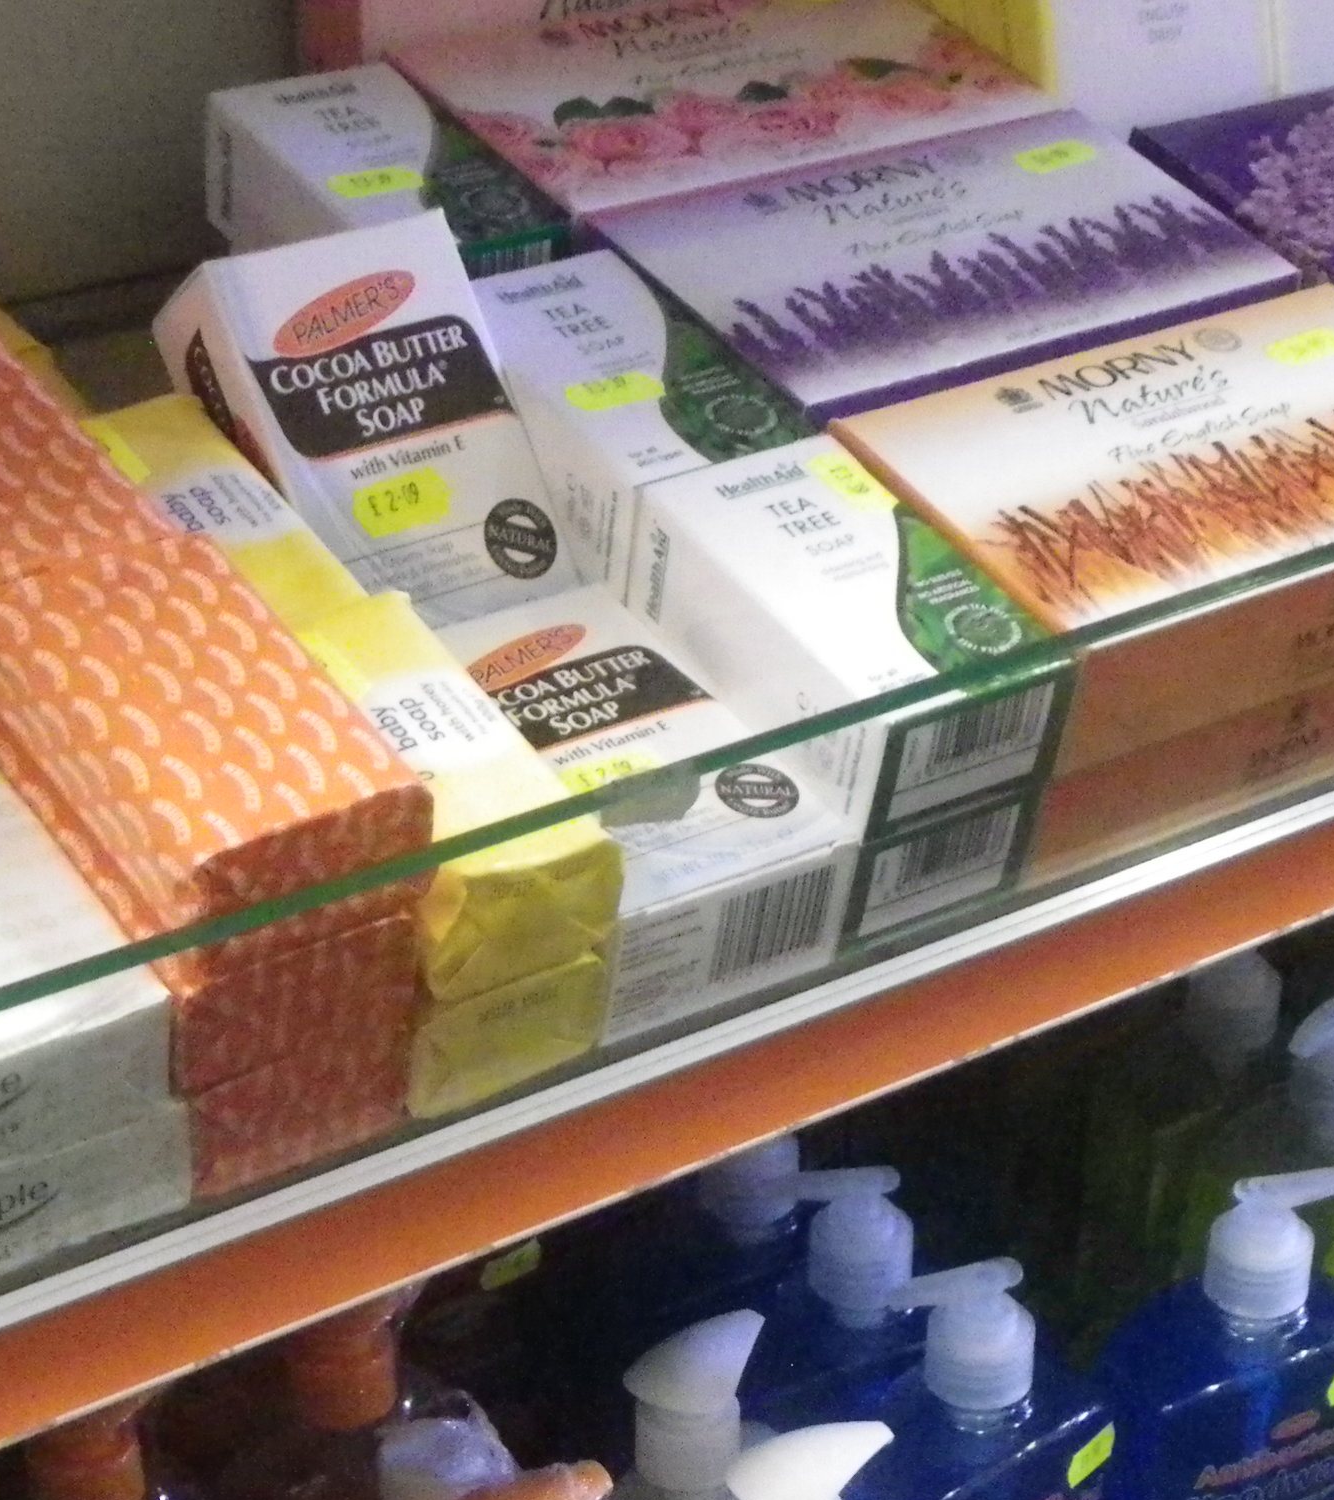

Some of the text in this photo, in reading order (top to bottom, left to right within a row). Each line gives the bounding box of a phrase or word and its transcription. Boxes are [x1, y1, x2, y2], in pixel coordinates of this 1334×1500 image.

[291, 278, 404, 345] PALMER'S
[543, 301, 588, 323] TEA
[552, 316, 612, 343] TREE
[271, 325, 468, 396] COCOA BUTTER
[1038, 340, 1195, 400] MORNY
[316, 363, 448, 416] FORMULA
[1068, 364, 1229, 425] Nature's
[356, 399, 425, 438] SOAP
[1109, 401, 1291, 463] Fine English Soap
[350, 435, 466, 480] with Vitamin E
[715, 462, 809, 499] HealthAid
[764, 496, 819, 518] TEA
[776, 510, 842, 540] TREE
[489, 525, 551, 551] NATURAL
[805, 533, 857, 557] SOAP
[470, 628, 574, 684] PALMER'S
[561, 651, 651, 690] BUTTER
[399, 697, 446, 741] soap
[510, 676, 635, 727] FORMULA
[549, 702, 619, 735] SOAP
[370, 704, 418, 752] baby
[554, 720, 671, 765] with Vitamin E
[720, 782, 792, 799] NATURAL
